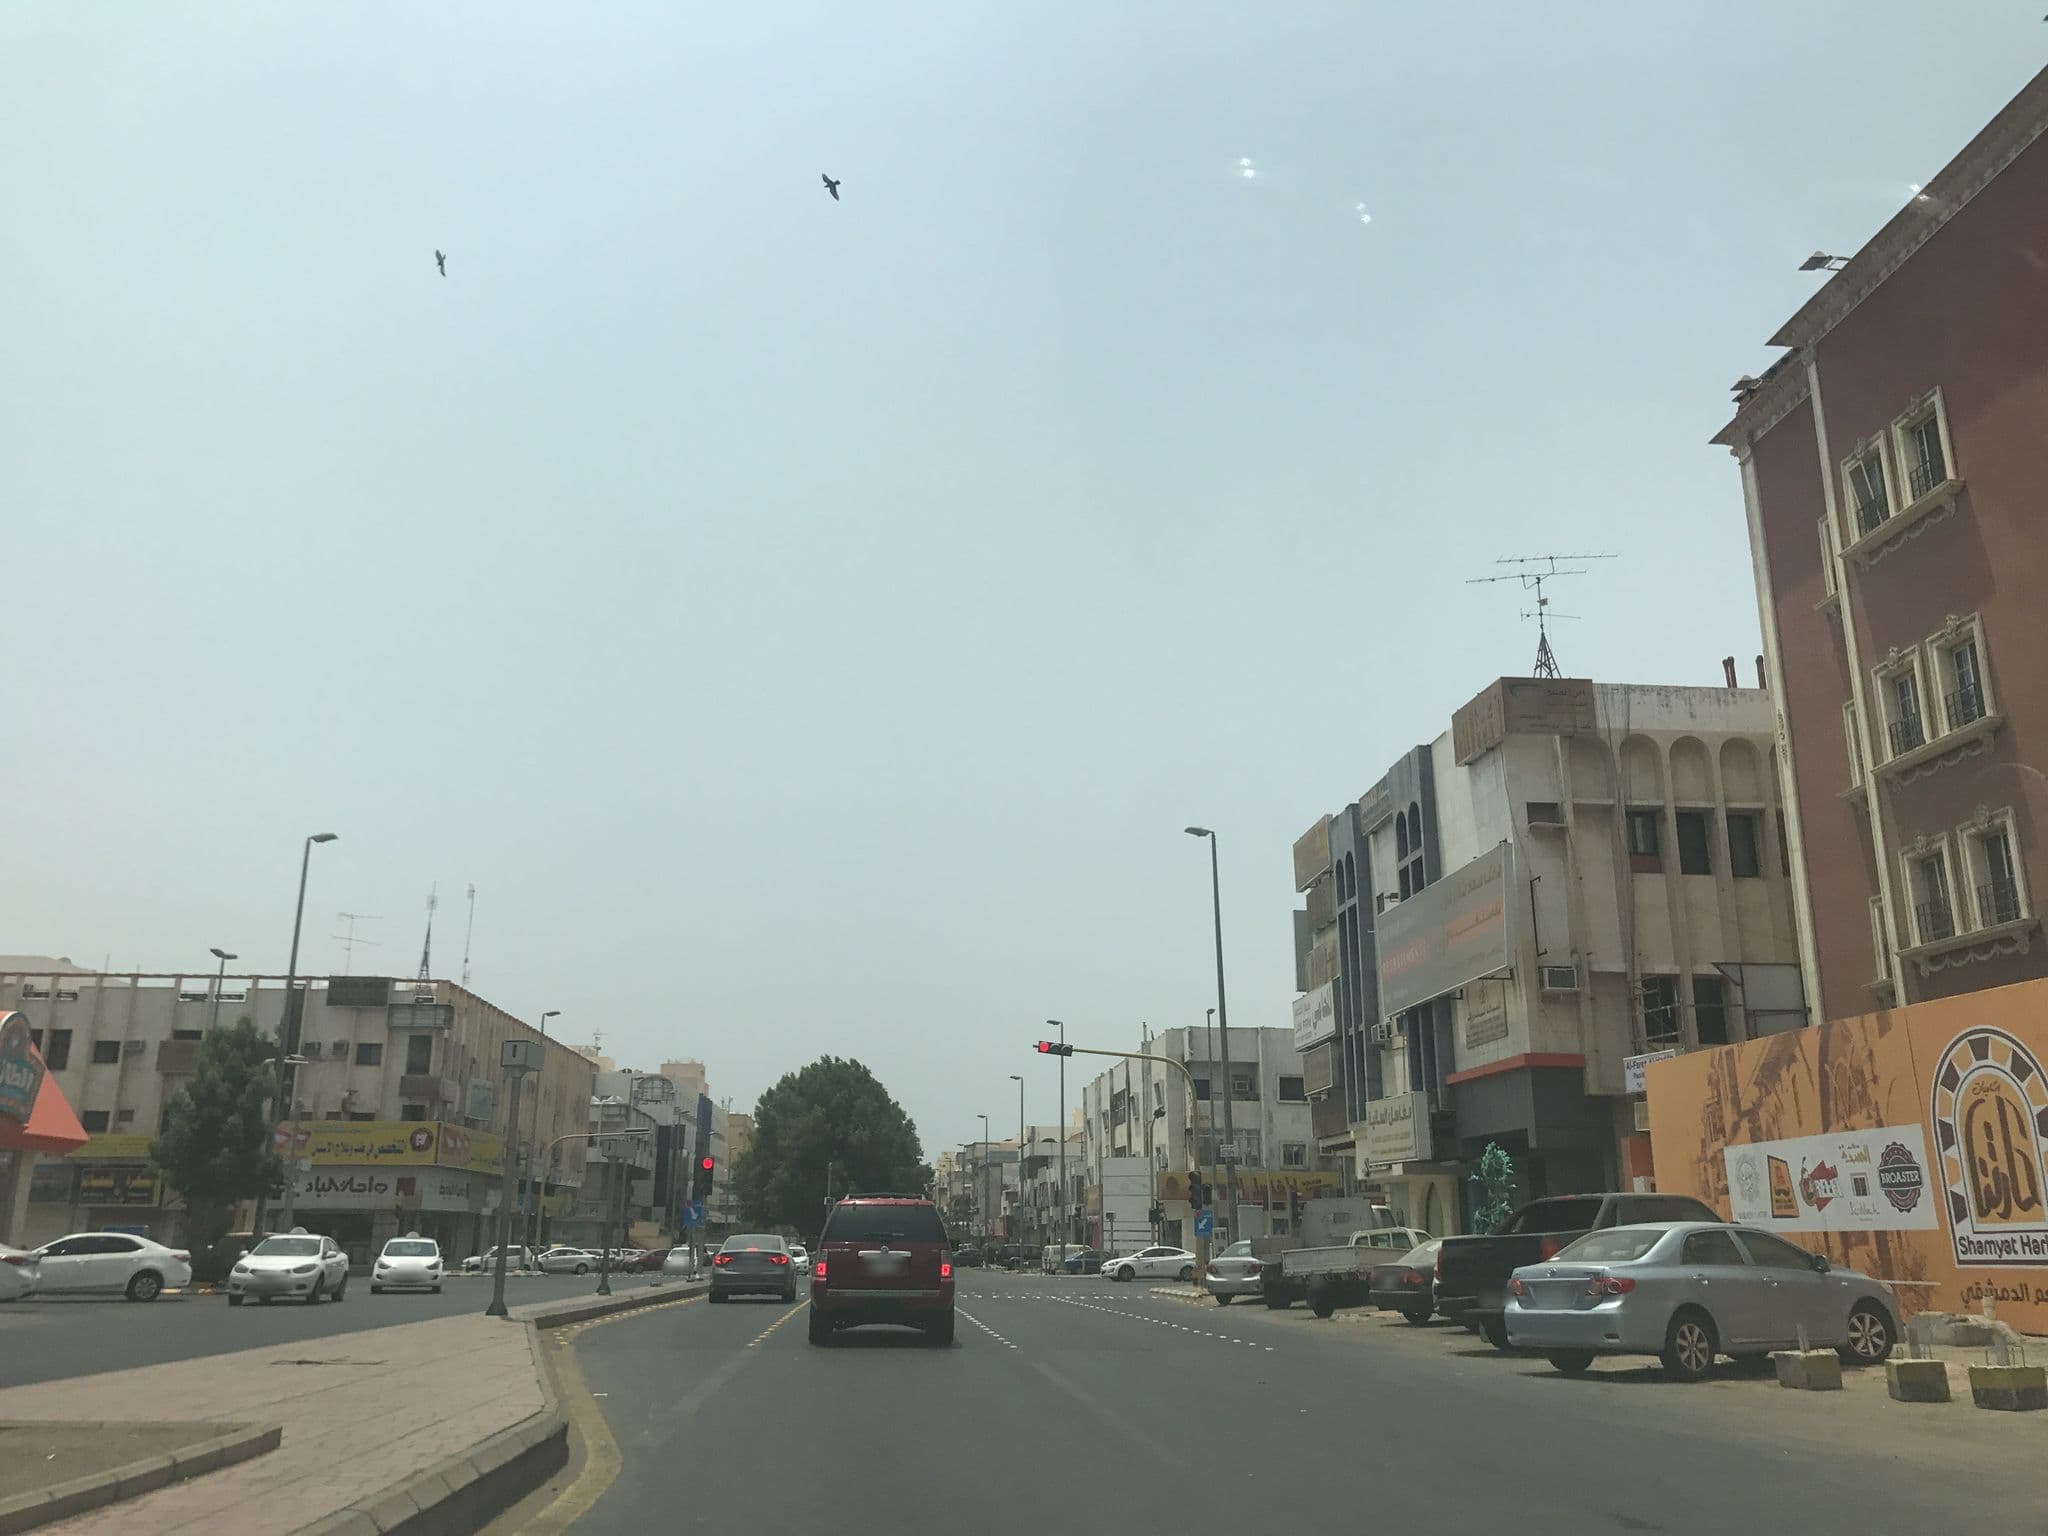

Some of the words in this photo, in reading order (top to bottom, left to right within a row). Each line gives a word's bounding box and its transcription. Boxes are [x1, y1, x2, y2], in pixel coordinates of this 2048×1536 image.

[1880, 1170, 1921, 1184] BROASTER
[1957, 1235, 2018, 1259] Shamyat
[2019, 1233, 2048, 1255] Har
[1960, 1277, 2030, 1310] الدمشقي
